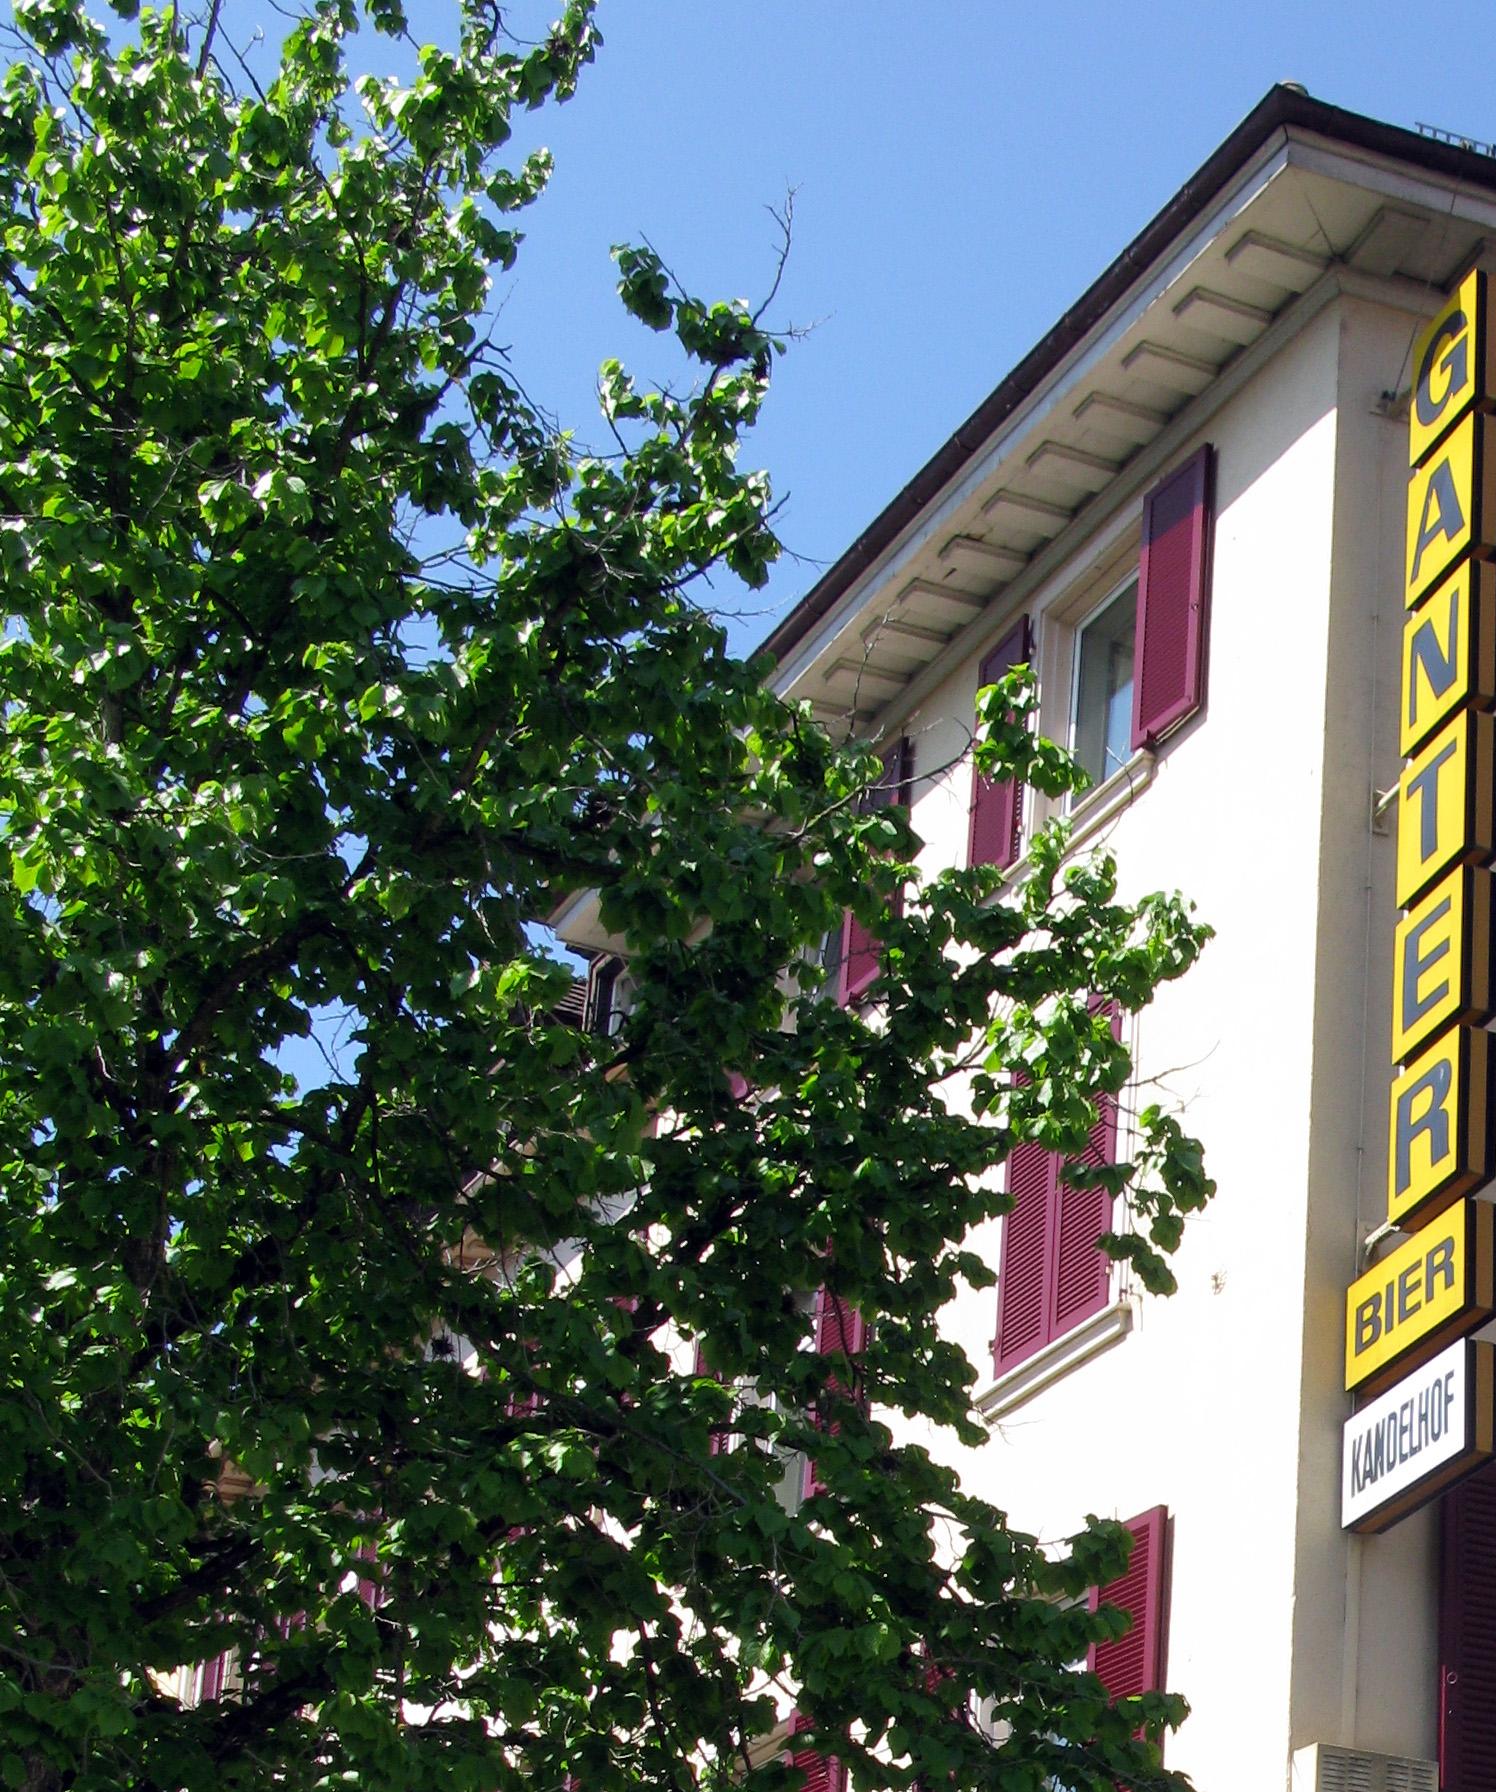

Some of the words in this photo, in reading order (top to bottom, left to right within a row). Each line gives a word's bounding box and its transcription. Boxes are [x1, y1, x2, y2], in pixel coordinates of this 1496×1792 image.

[1394, 307, 1469, 1199] GANTER
[1355, 1235, 1457, 1358] BIER
[1350, 1368, 1456, 1499] KANDELHOF
